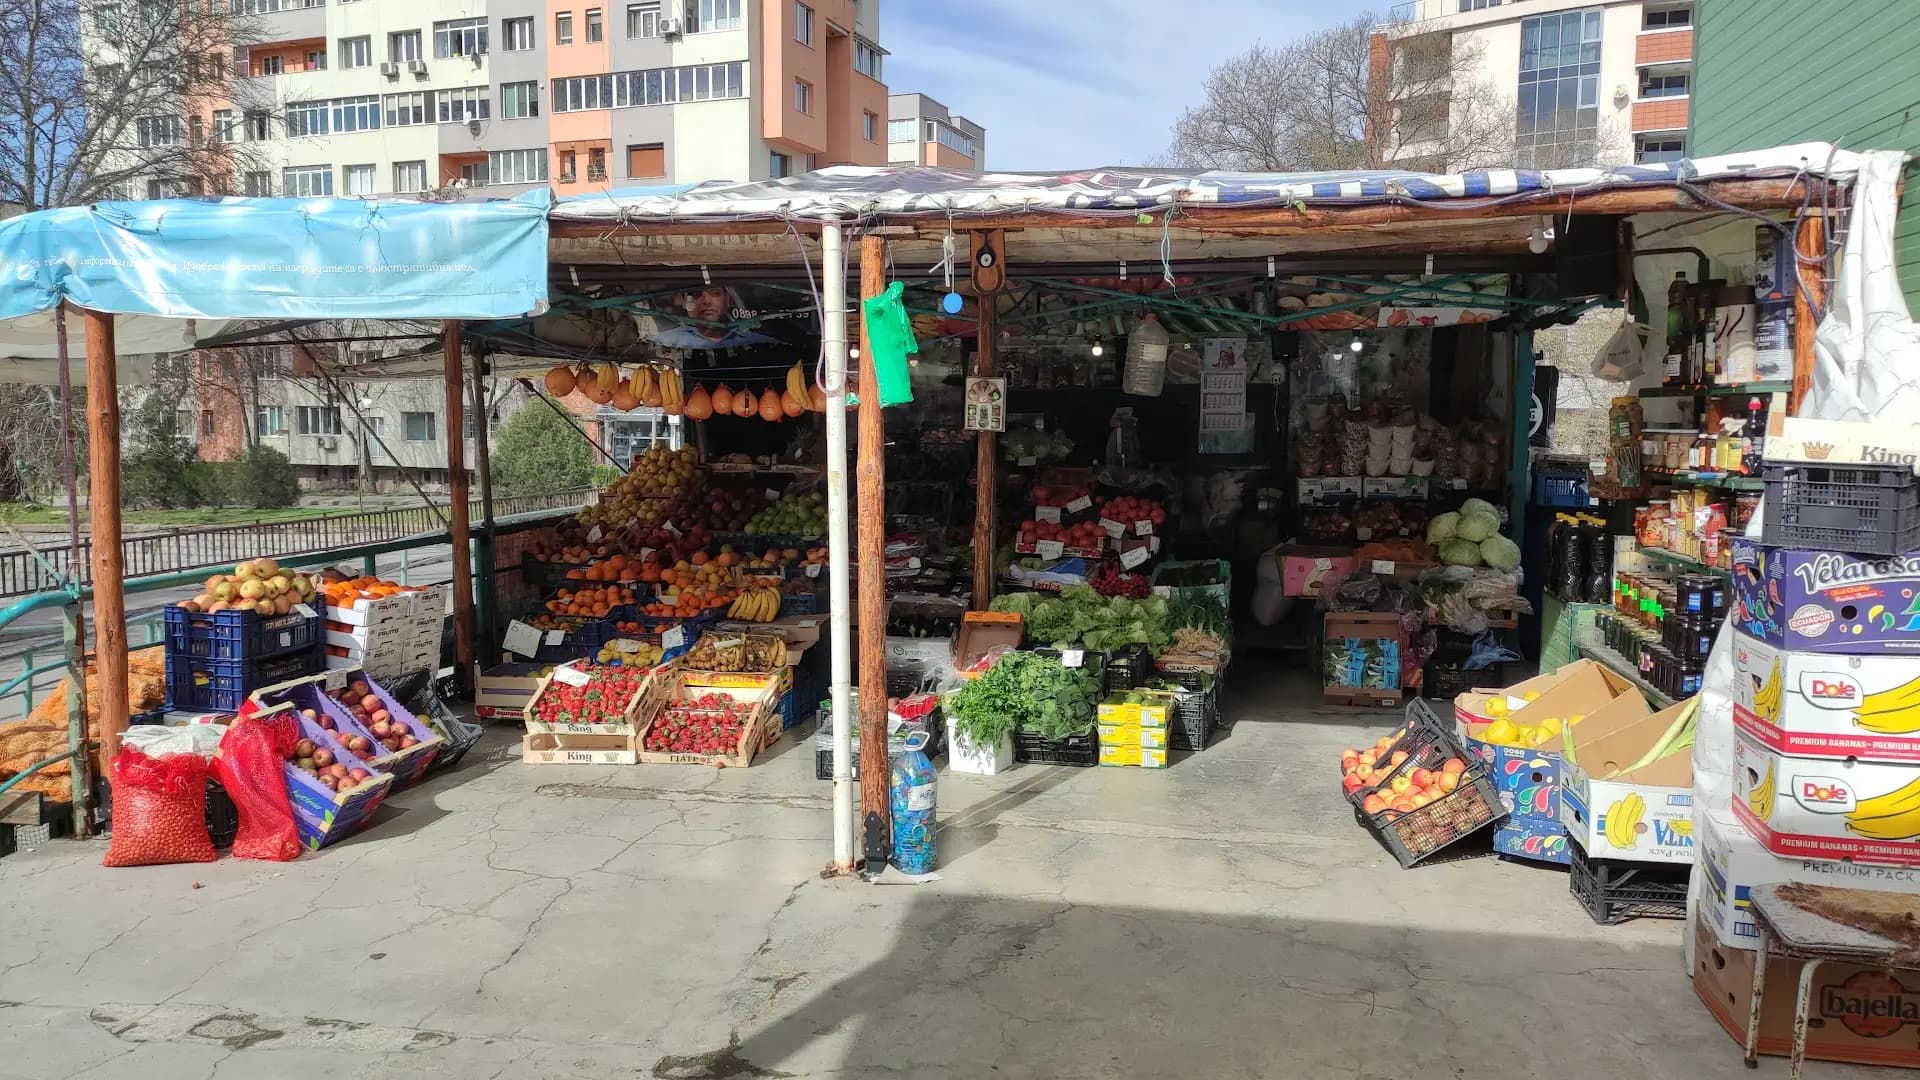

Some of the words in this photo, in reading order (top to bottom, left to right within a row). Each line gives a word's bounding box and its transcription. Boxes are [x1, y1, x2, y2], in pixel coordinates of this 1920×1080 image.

[1791, 613, 1832, 629] ECUADOR
[1812, 679, 1856, 698] Dole
[1790, 736, 1827, 746] PREMIUM
[1828, 738, 1867, 749] BANANAS
[1872, 741, 1911, 750] PREMIUM
[567, 751, 593, 763] King
[1804, 783, 1848, 800] Dole
[1780, 838, 1818, 849] PREMIUM
[1819, 840, 1858, 852] BANANAS
[1864, 845, 1902, 855] PREMIUM
[1802, 861, 1870, 878] PREMIUM
[1876, 868, 1914, 881] PACK
[1827, 989, 1918, 1019] bajella
